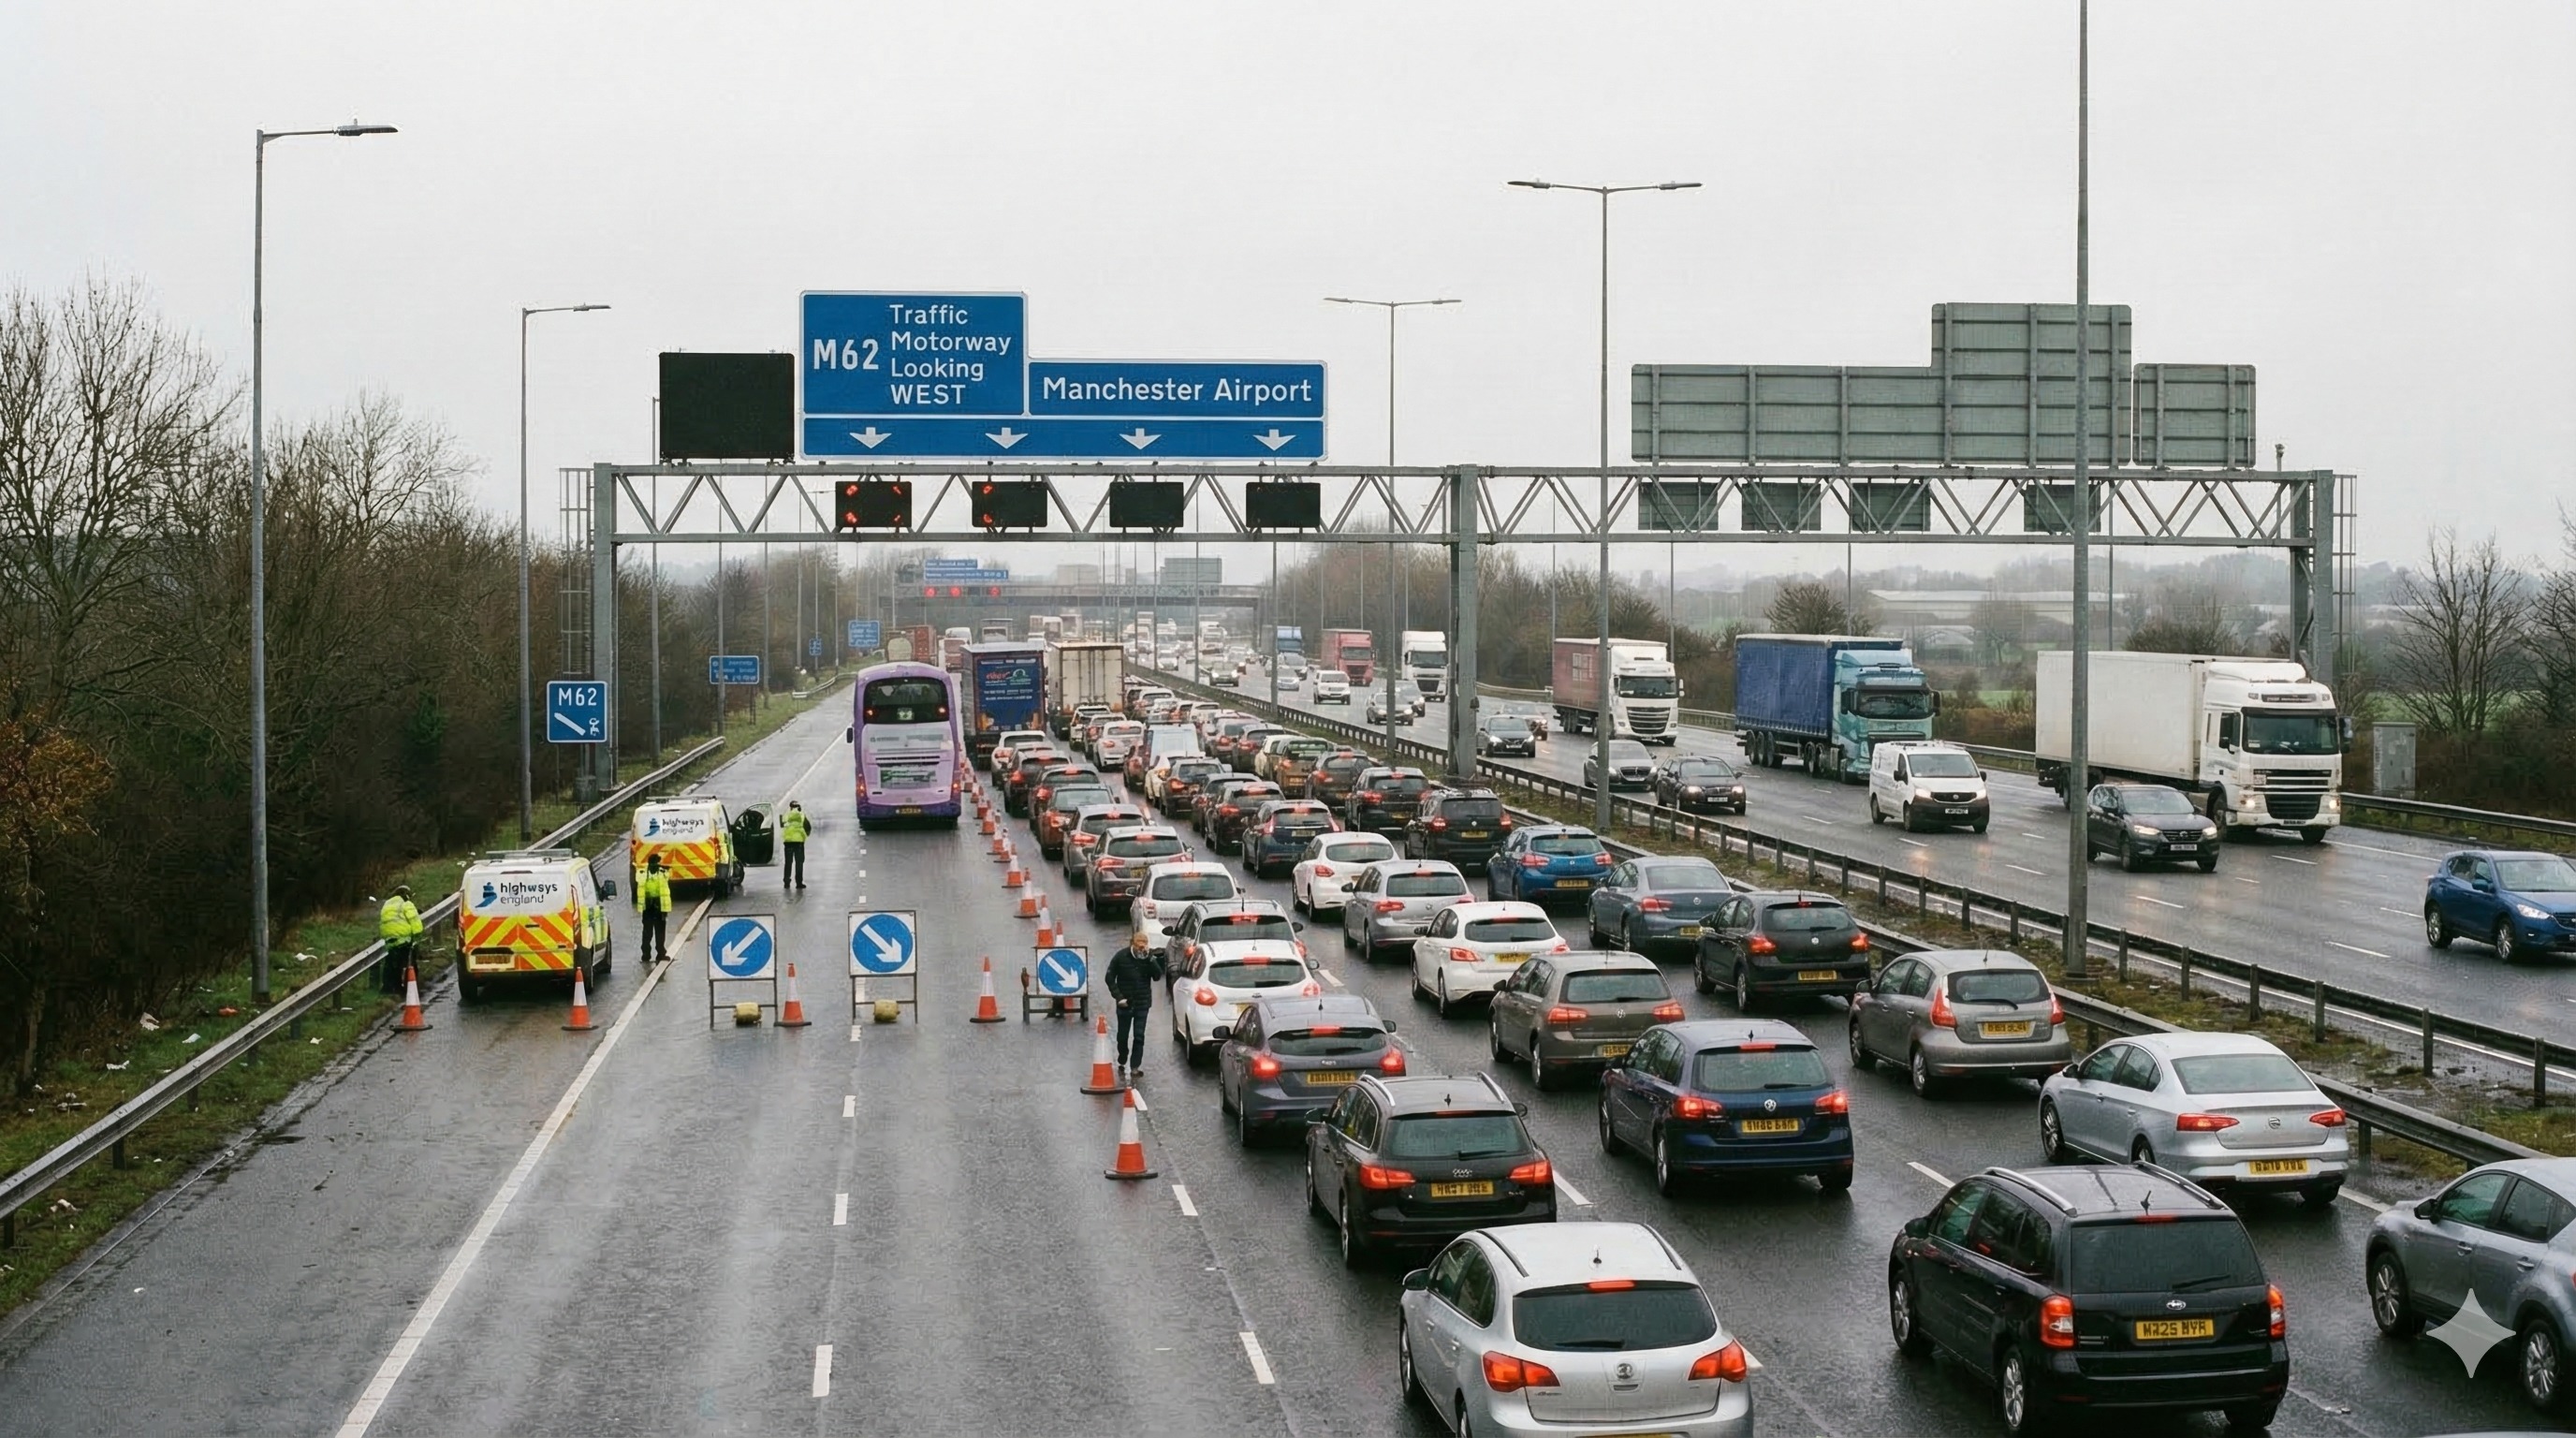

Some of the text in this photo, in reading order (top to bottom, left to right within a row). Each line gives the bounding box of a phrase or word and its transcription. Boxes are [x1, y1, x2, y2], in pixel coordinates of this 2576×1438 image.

[889, 305, 967, 325] Traffic
[813, 340, 879, 370] M62
[891, 332, 1011, 356] Motorway
[891, 359, 984, 381] Looking
[891, 385, 965, 404] WEST
[1043, 376, 1312, 405] Manchester Airport
[558, 687, 597, 706] M62
